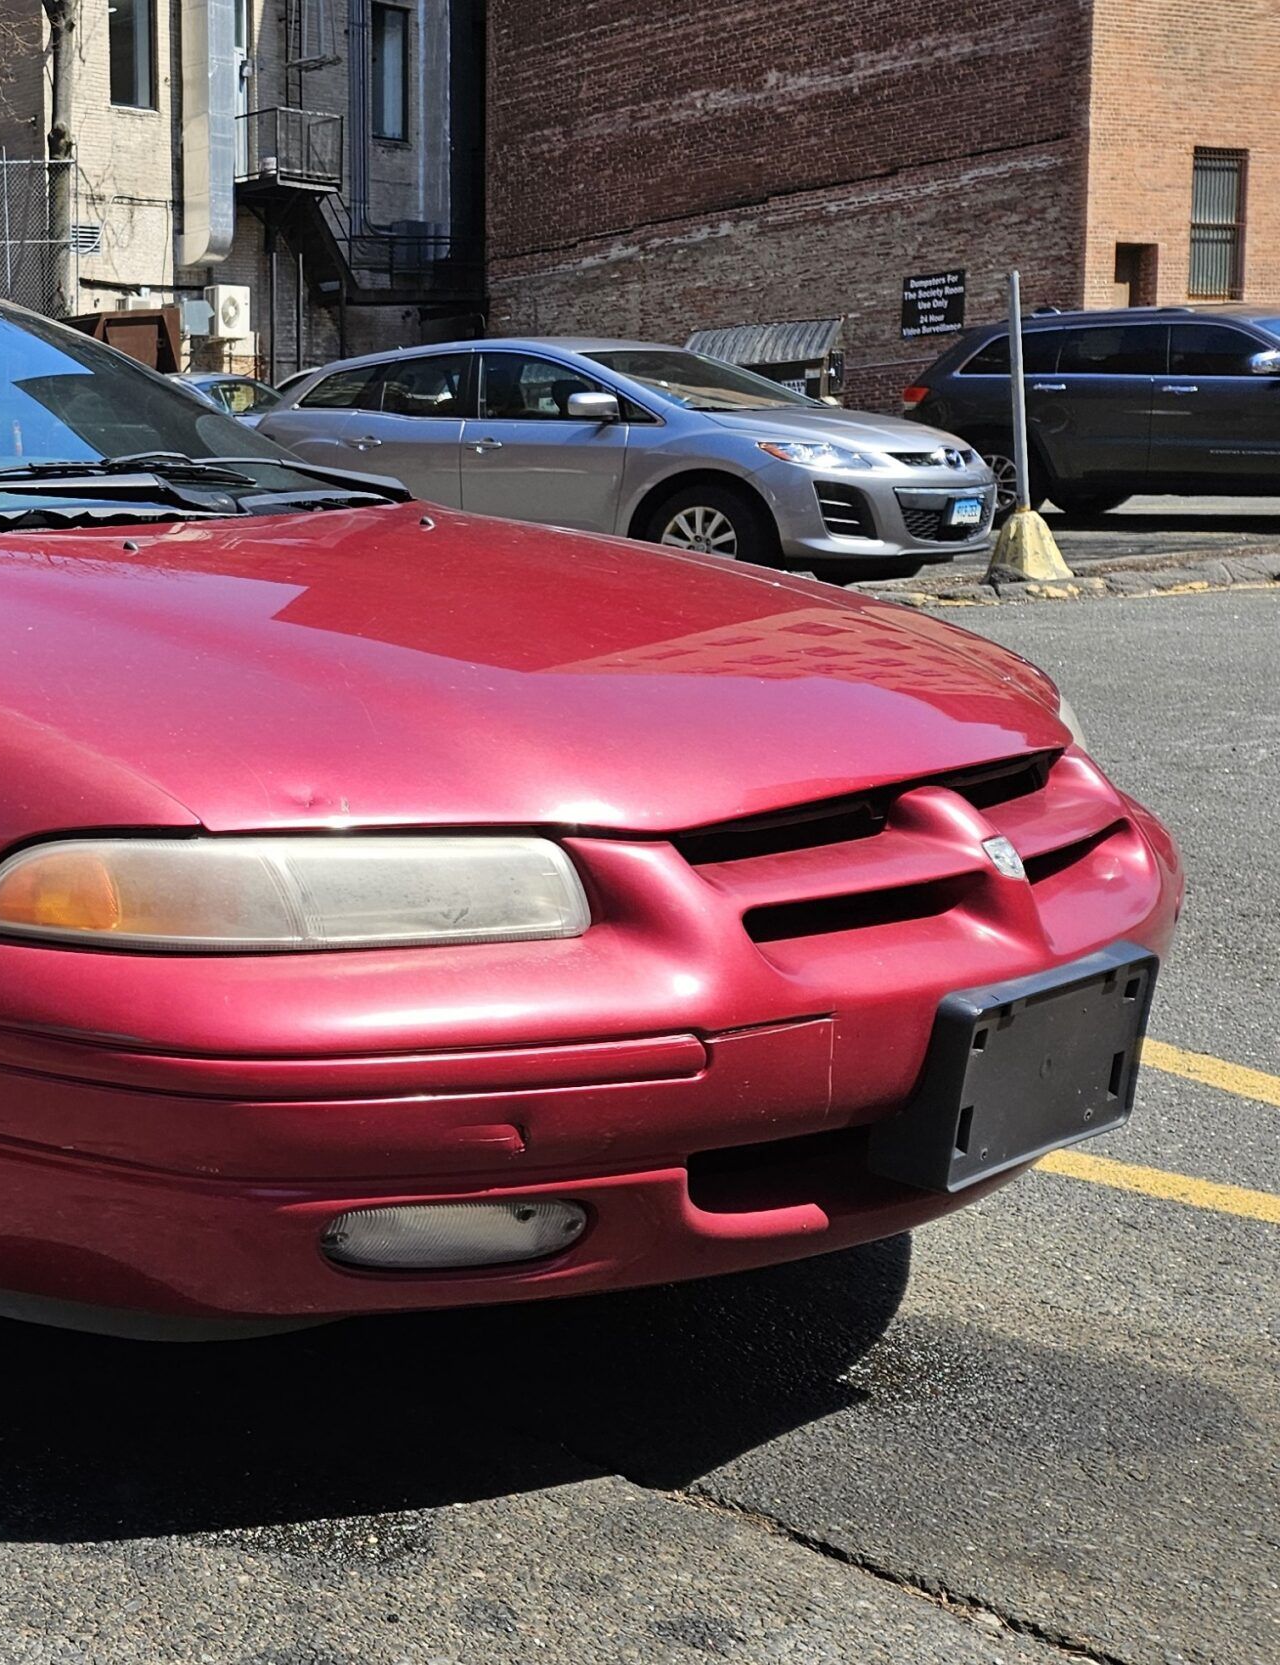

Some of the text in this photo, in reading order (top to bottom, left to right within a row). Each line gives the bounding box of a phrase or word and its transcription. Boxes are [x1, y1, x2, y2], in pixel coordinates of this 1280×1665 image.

[910, 274, 958, 288] Dumpsters For
[904, 286, 964, 300] The Society Room
[918, 298, 949, 310] Use Only
[903, 323, 961, 336] Video Surveillance
